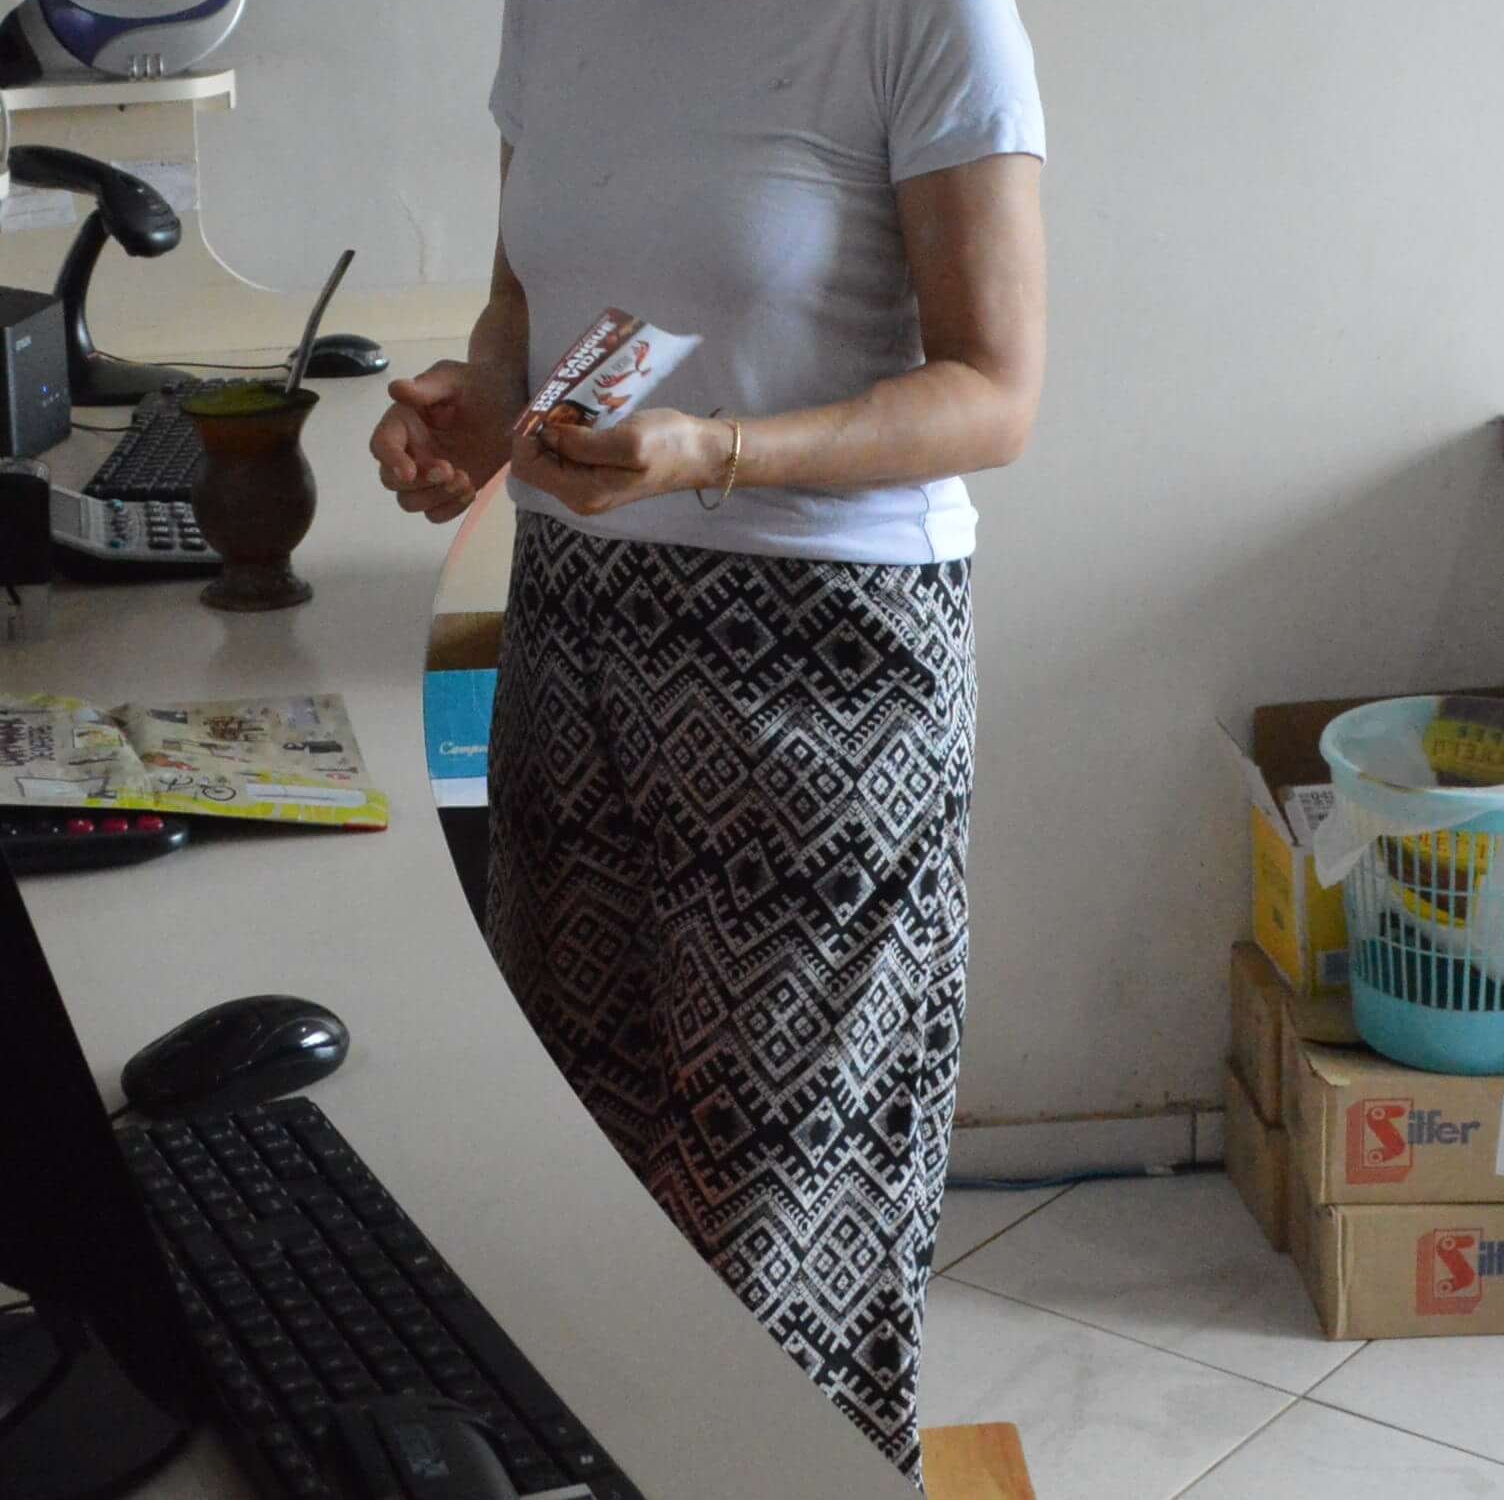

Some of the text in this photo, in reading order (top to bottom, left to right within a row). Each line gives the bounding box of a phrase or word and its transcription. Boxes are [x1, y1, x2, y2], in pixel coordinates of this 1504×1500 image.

[532, 320, 618, 412] DOE SANGUE
[541, 346, 607, 412] DOE VIDA
[1364, 1103, 1481, 1166] Silfer
